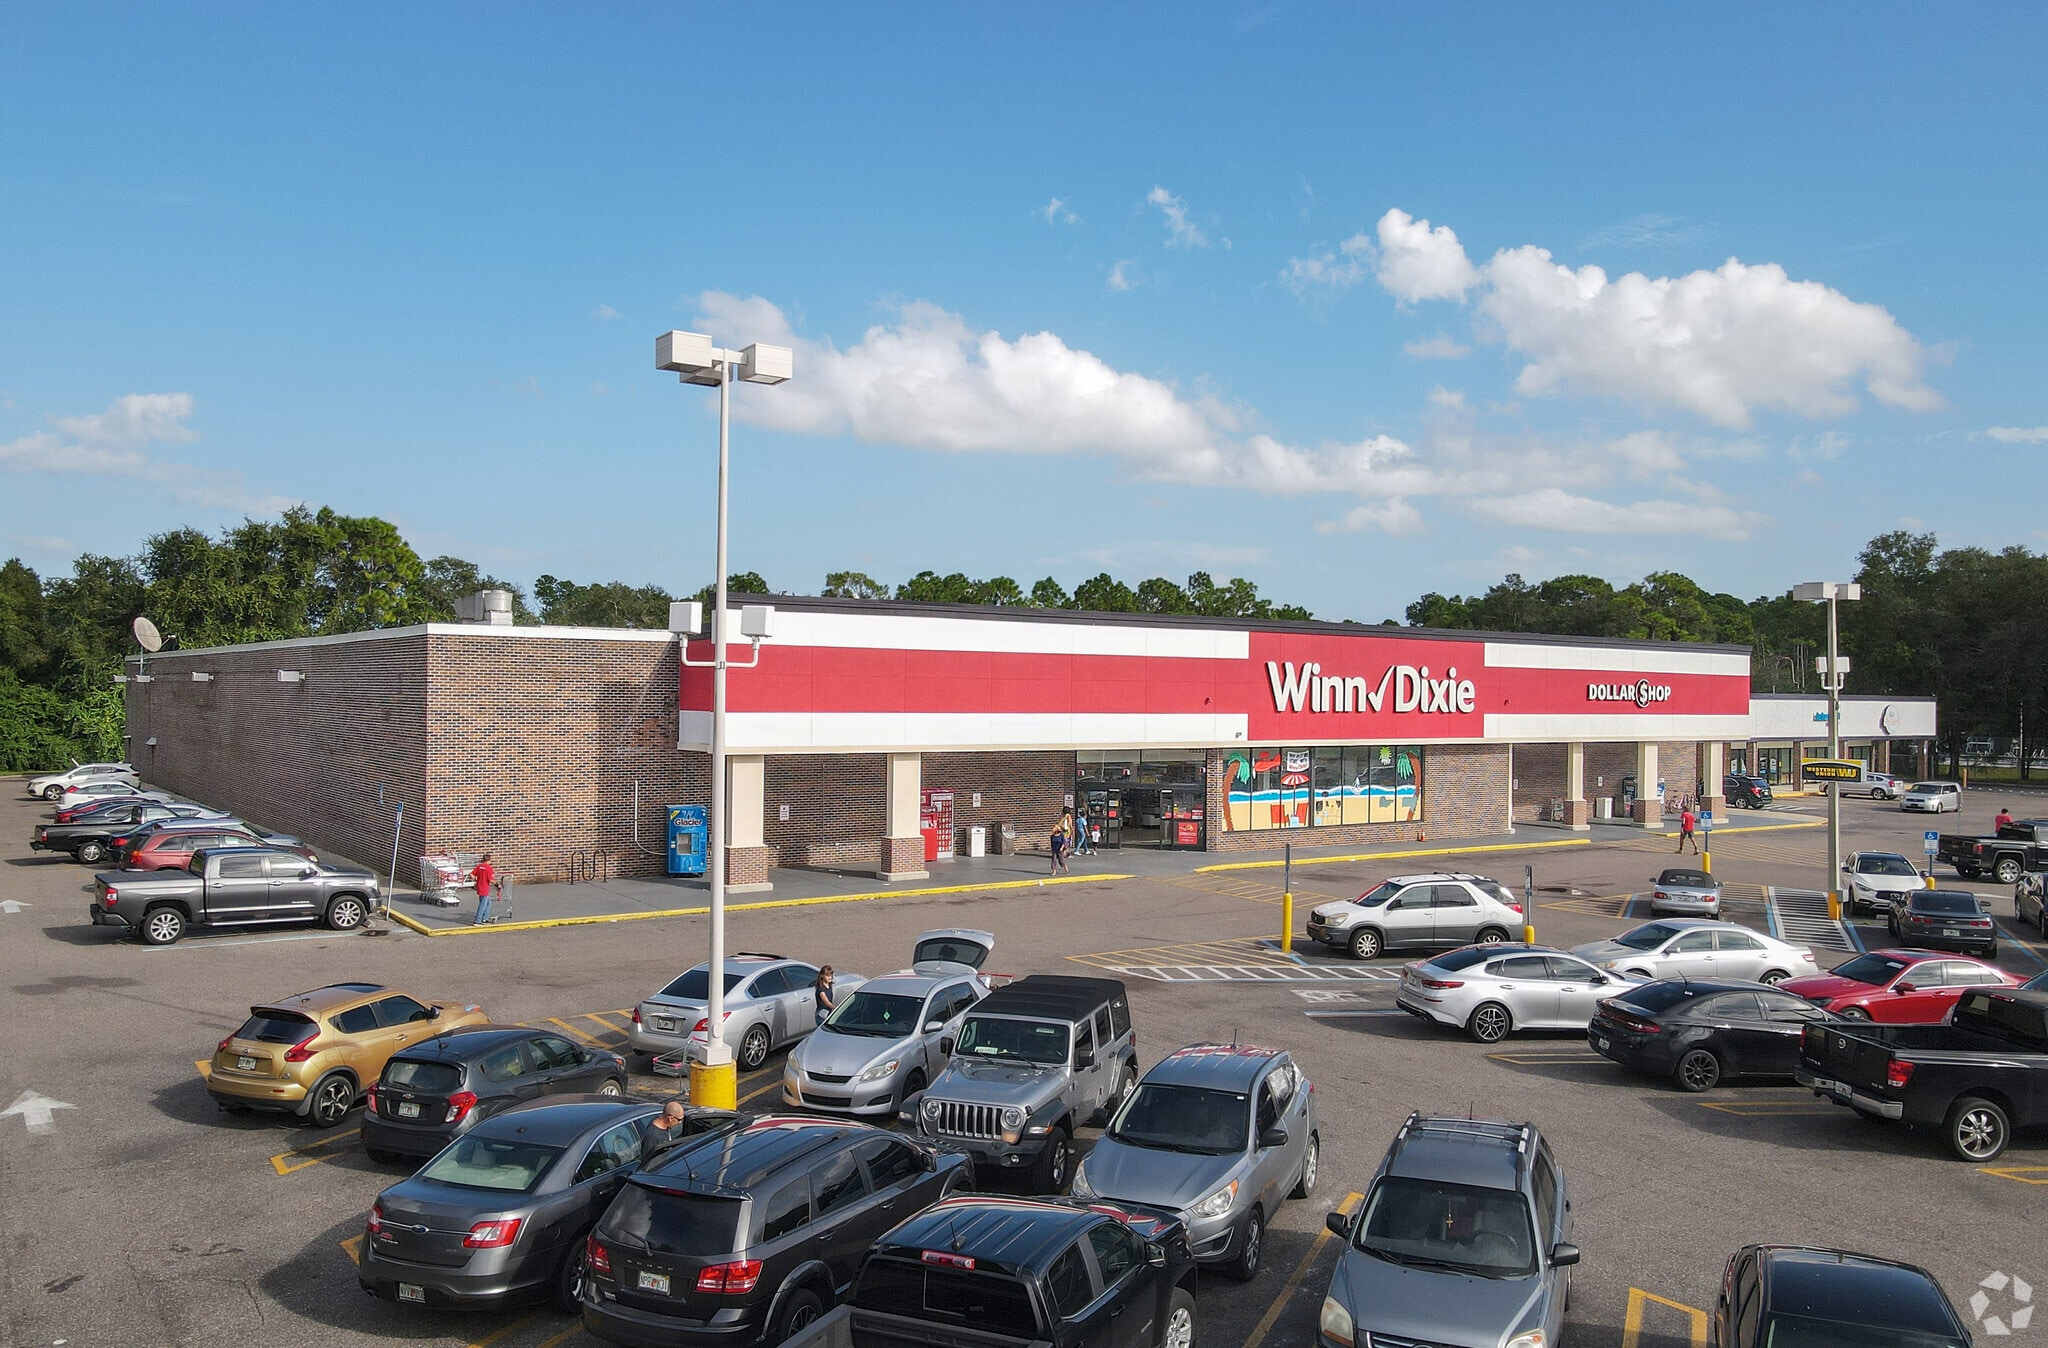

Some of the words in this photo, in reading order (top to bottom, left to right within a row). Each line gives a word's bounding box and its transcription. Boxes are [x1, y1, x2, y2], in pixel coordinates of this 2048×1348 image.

[1265, 661, 1367, 713] Winn
[1394, 665, 1475, 713] Dixie
[1587, 684, 1636, 701] DOLLAR
[674, 818, 703, 826] Glacier
